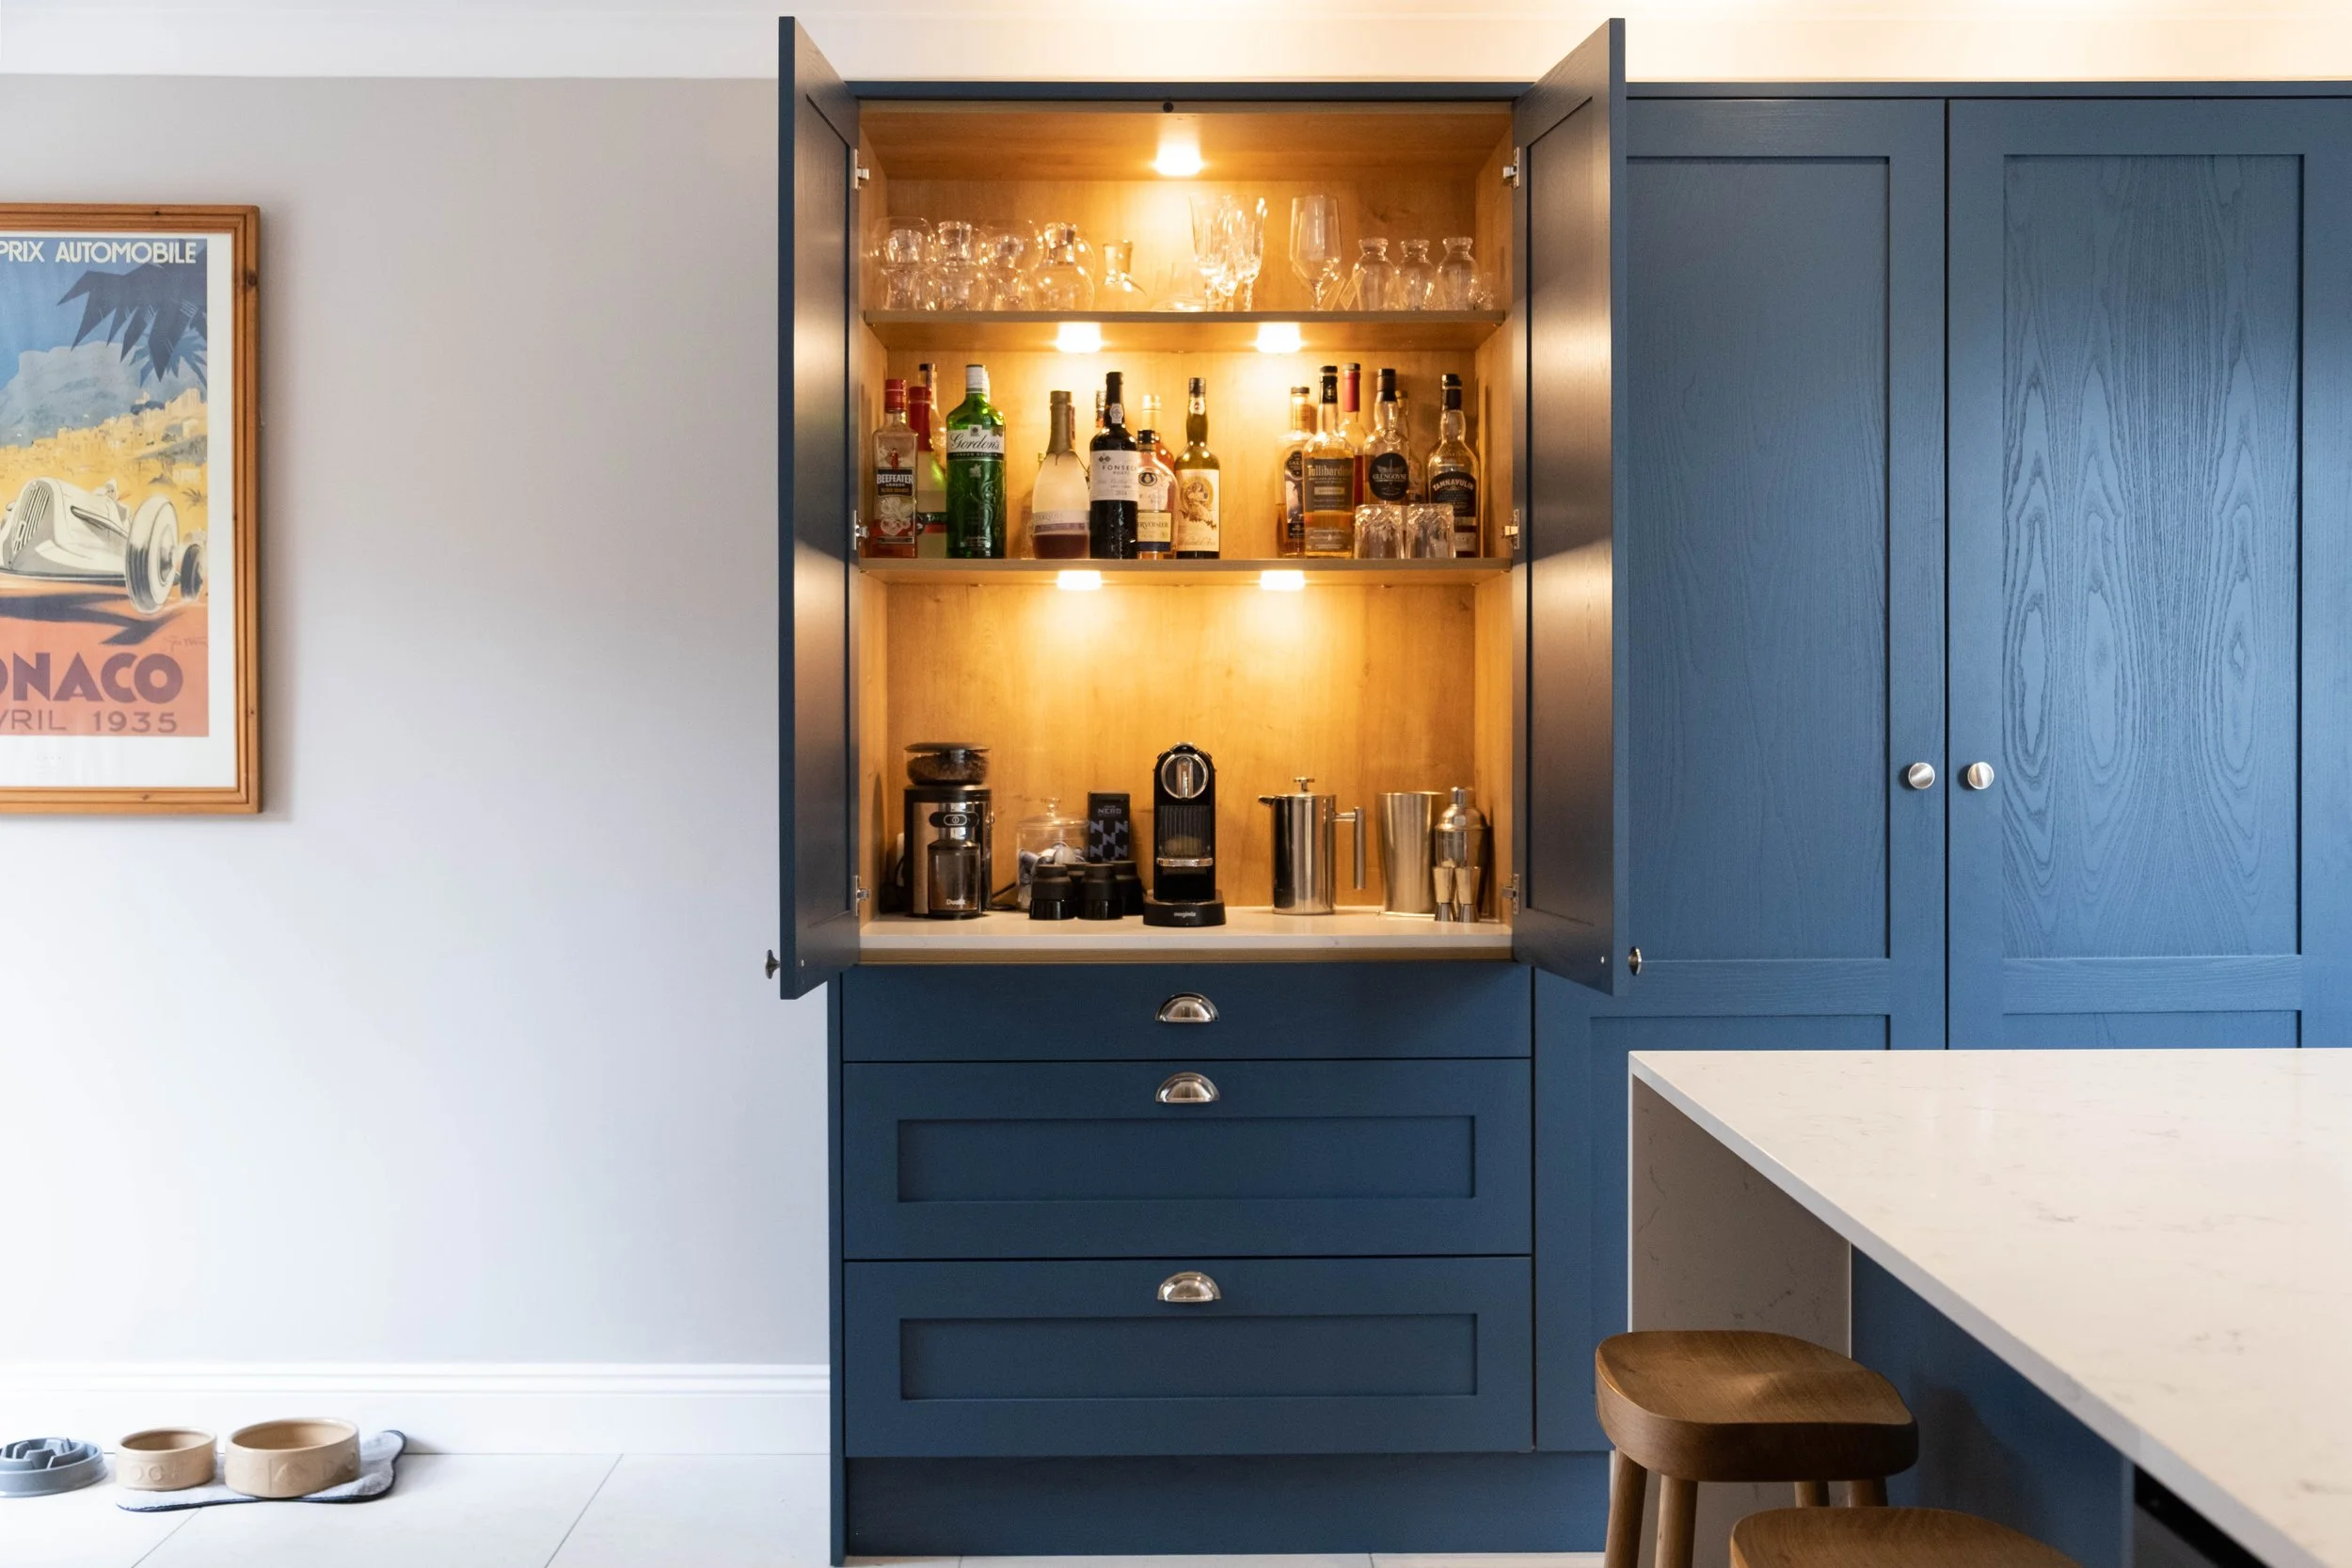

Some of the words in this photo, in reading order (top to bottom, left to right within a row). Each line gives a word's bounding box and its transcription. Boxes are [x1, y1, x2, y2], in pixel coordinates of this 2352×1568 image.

[0, 240, 45, 262] PRIX
[56, 241, 197, 264] AUTOMOBILE
[876, 473, 914, 484] BEEFEATER
[0, 652, 183, 705] NACO
[93, 710, 178, 734] 1935
